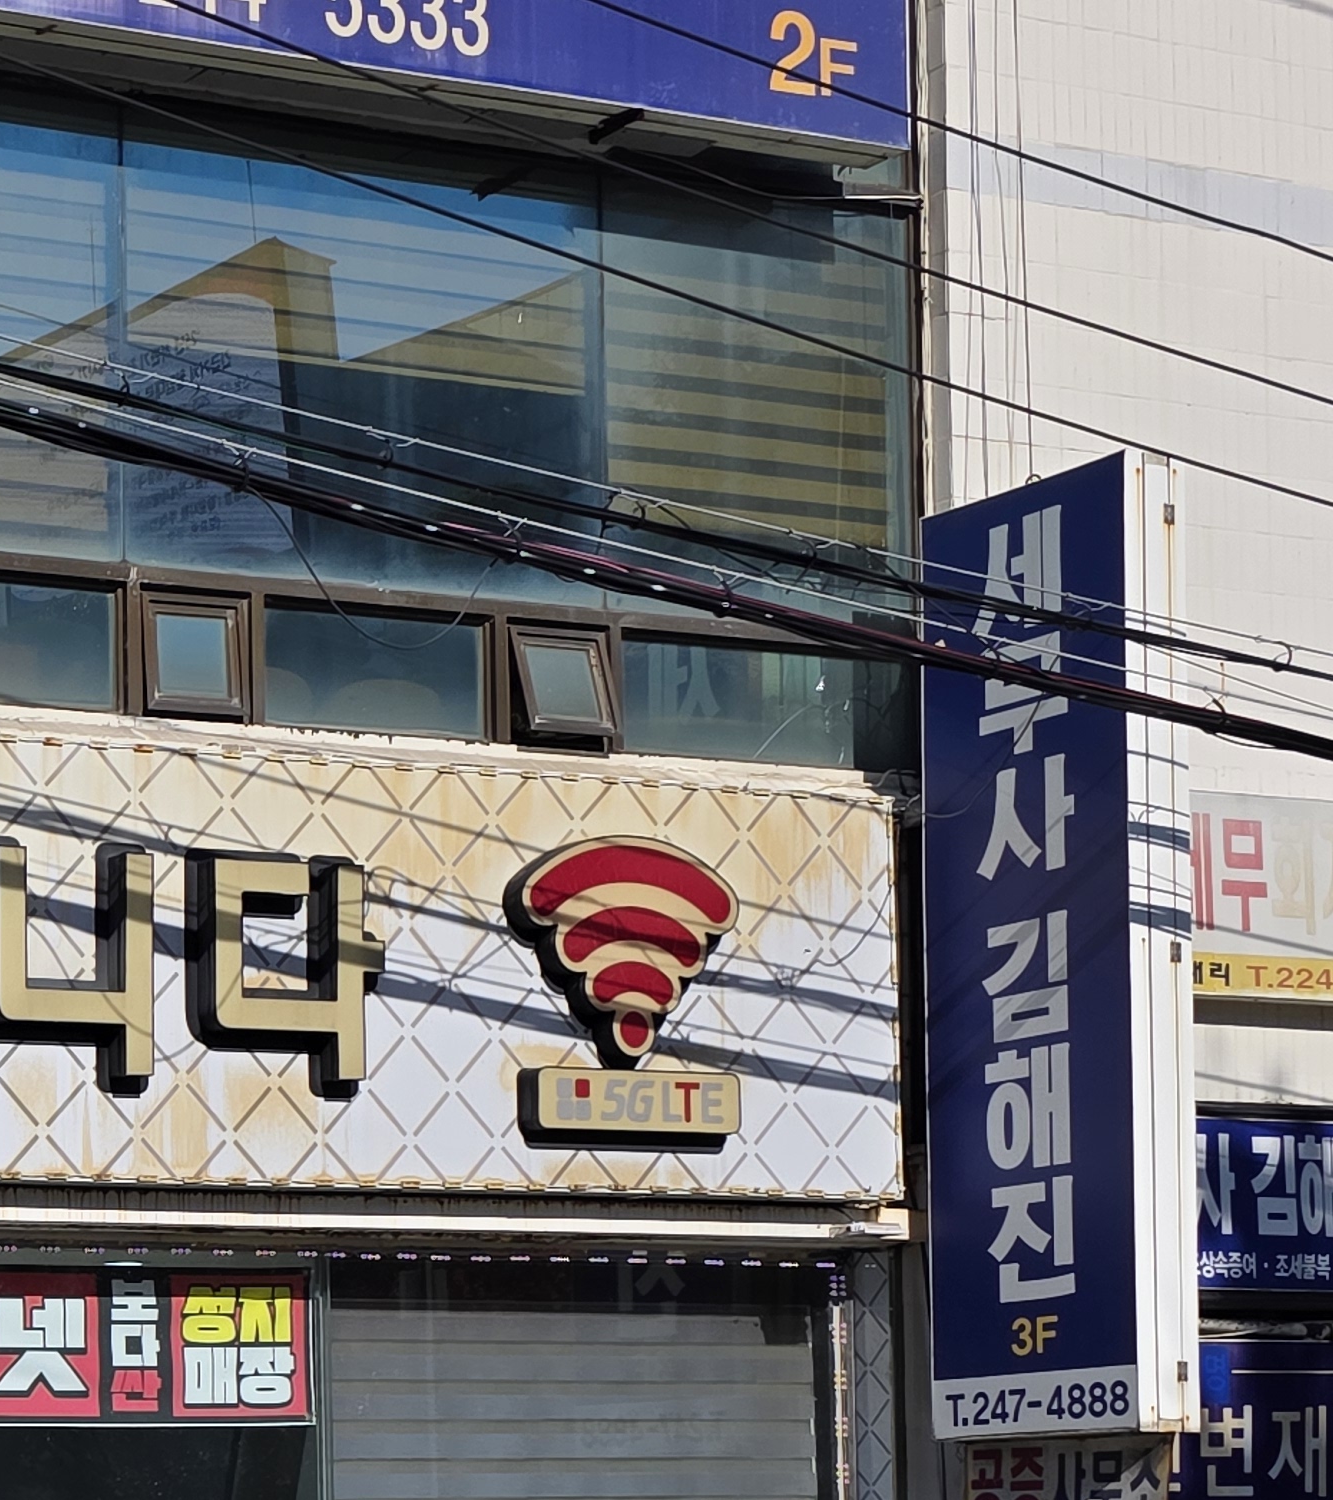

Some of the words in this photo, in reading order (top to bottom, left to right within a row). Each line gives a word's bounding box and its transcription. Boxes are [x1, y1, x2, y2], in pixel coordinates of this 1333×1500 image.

[769, 10, 859, 97] 2F
[982, 908, 1076, 1304] 김해진
[1197, 1252, 1257, 1278] 상속증여
[183, 1286, 292, 1343] 성지
[1010, 1315, 1059, 1357] 3F
[183, 1347, 295, 1404] 매장
[944, 1380, 1131, 1428] T.247-4888
